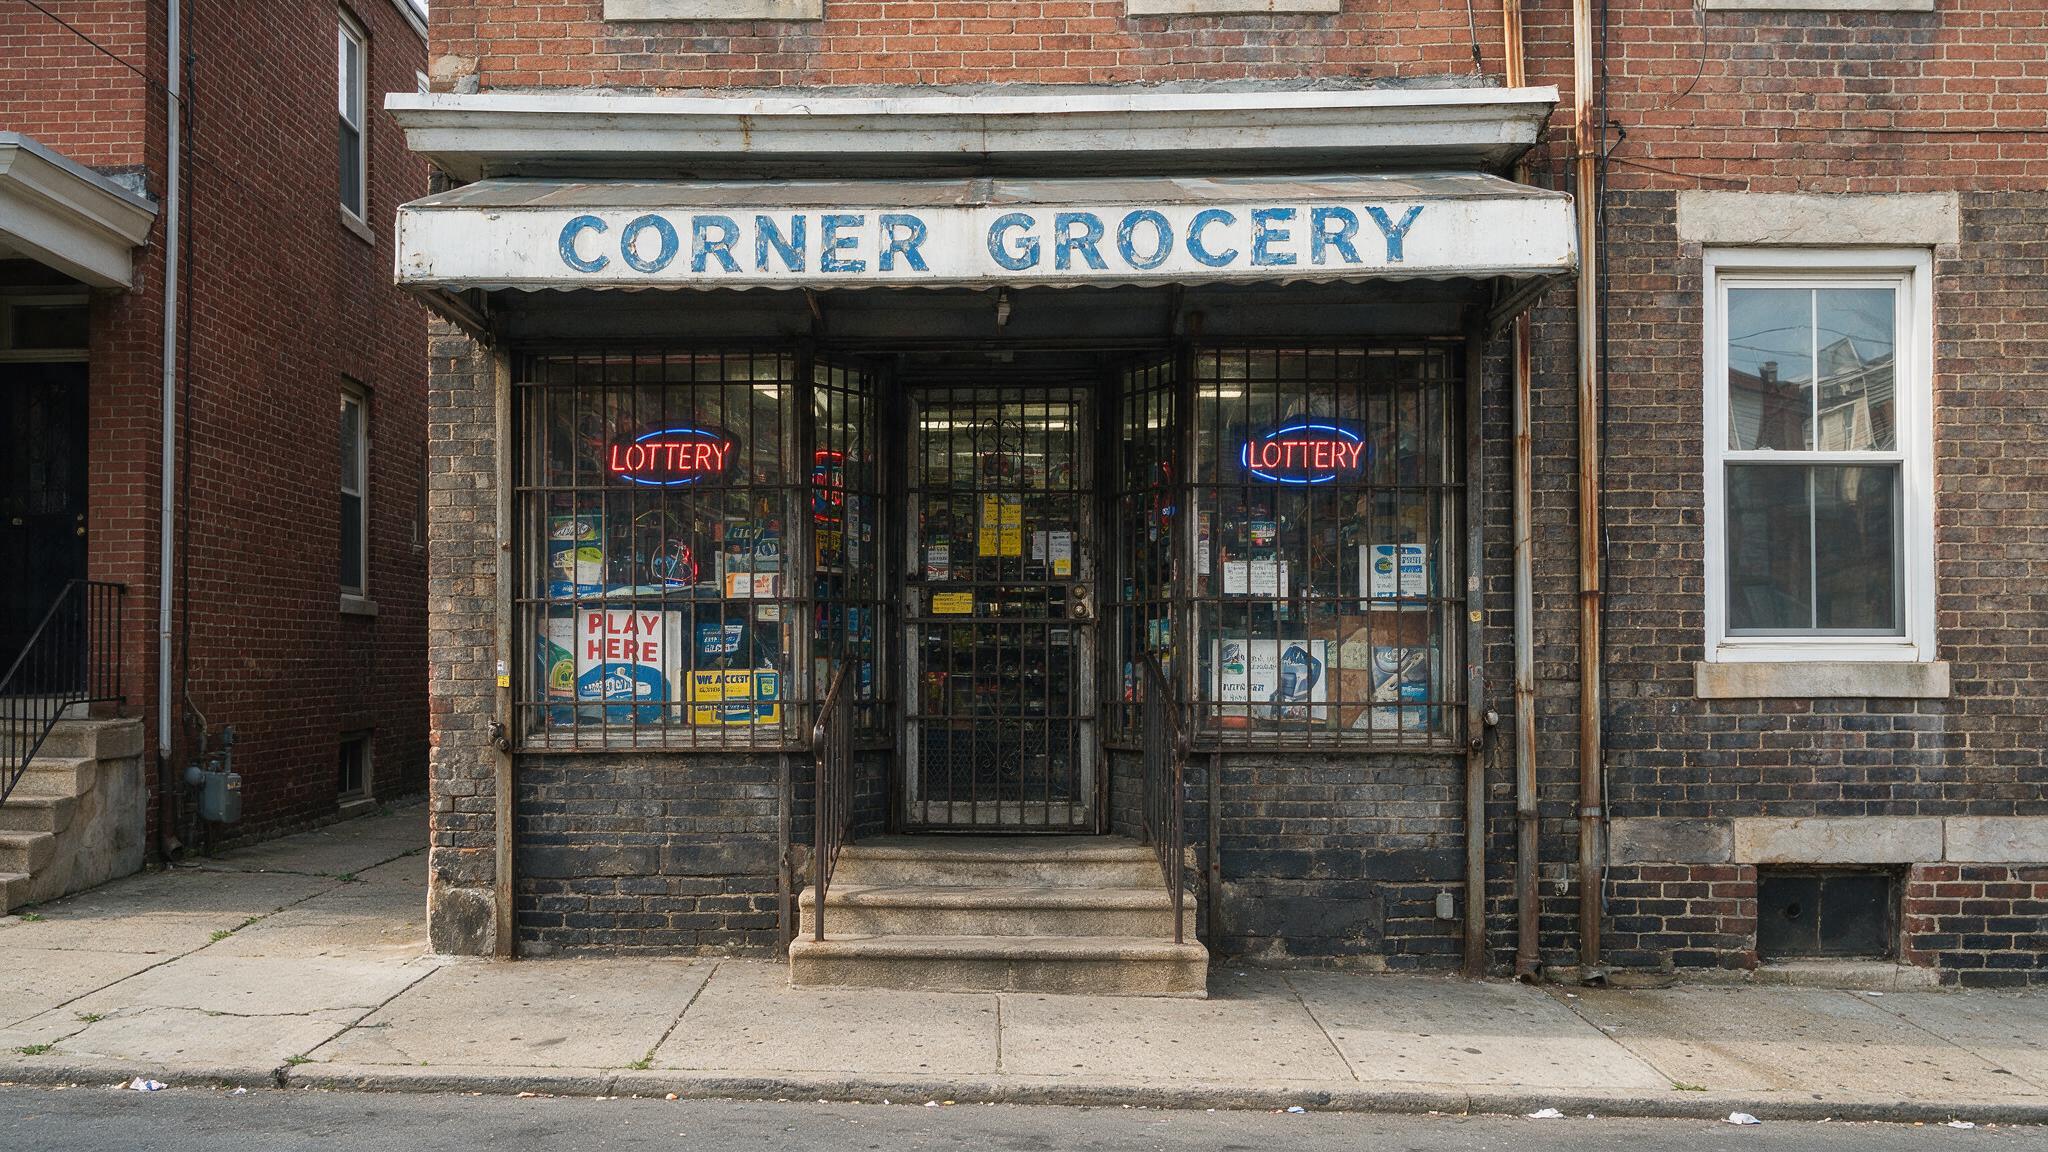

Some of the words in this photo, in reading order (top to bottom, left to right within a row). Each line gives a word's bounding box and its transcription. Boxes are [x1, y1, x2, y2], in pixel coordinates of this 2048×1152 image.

[557, 213, 930, 274] CORNER
[986, 205, 1425, 271] GROCERY
[610, 441, 731, 471] LOTTERY
[1249, 440, 1364, 470] LOTTERY
[588, 613, 660, 636] PLAY
[587, 638, 658, 662] HERE
